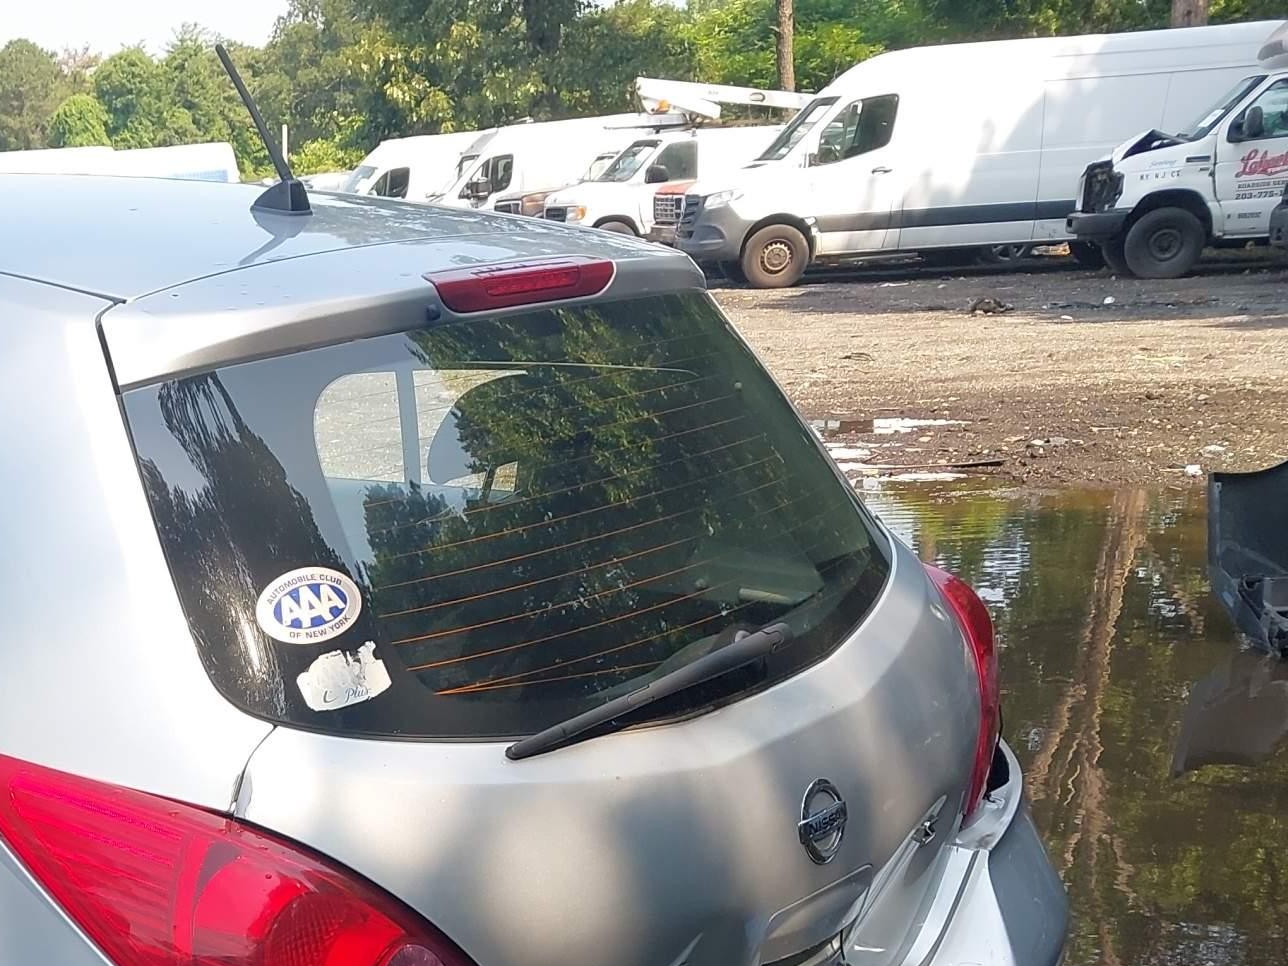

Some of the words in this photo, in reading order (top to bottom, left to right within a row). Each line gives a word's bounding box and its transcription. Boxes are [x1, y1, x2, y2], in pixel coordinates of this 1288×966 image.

[267, 574, 317, 606] AUTOMOBILE
[319, 573, 343, 586] CLUB
[280, 584, 347, 629] AAA
[289, 631, 304, 639] OF
[305, 630, 328, 639] NEW
[329, 614, 352, 633] YORK
